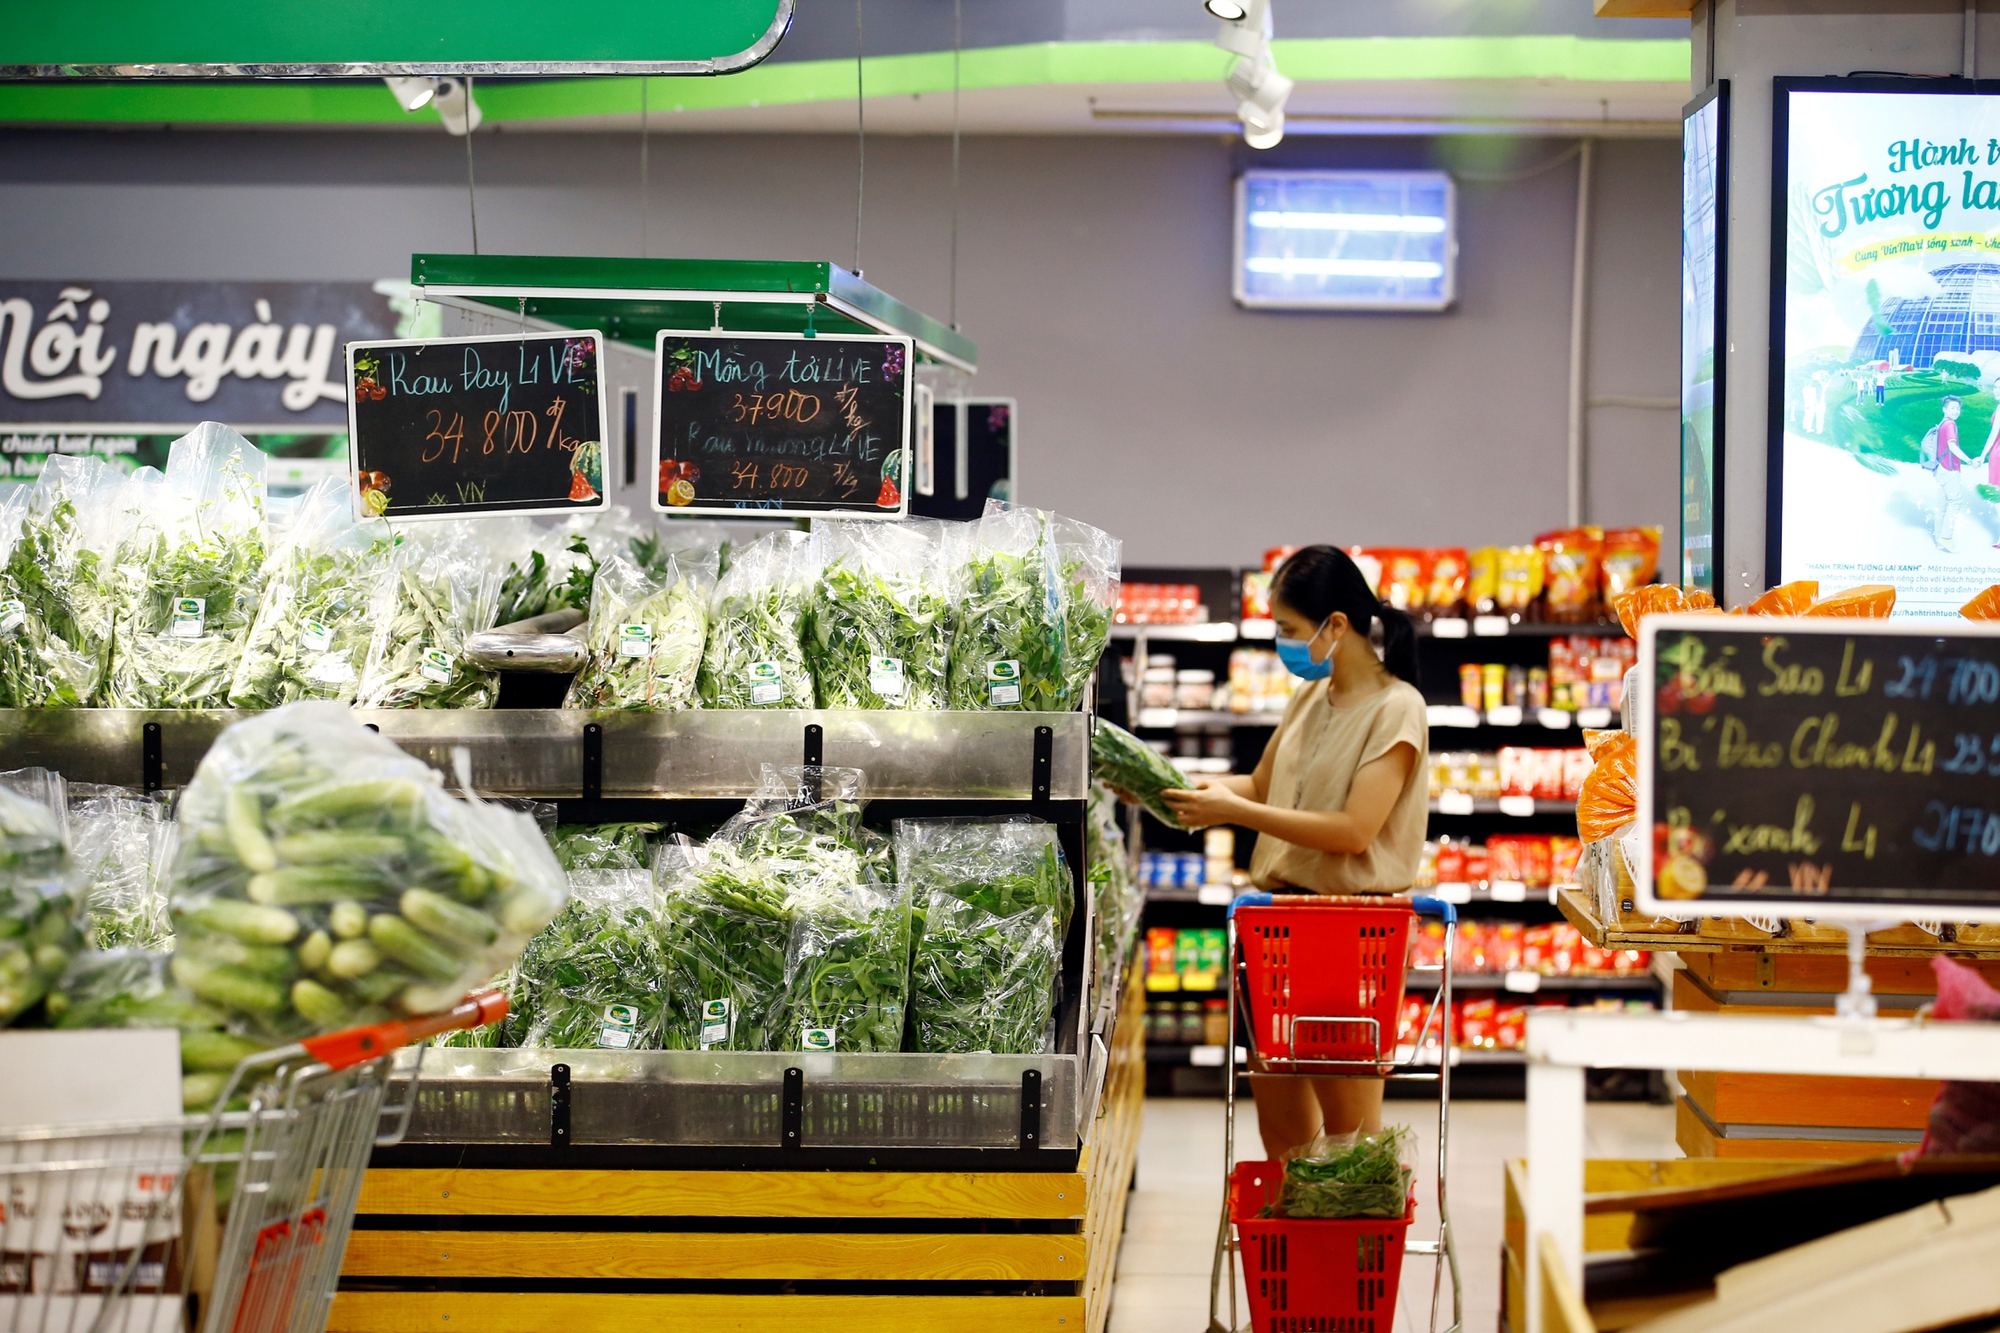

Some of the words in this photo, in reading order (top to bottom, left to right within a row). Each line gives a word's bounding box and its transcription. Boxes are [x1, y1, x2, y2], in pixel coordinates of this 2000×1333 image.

[1888, 138, 1979, 173] Hành
[1987, 138, 2000, 166] t
[1812, 172, 1951, 238] Tương
[1962, 170, 2000, 210] la
[127, 298, 347, 411] ngày
[460, 347, 512, 415] Đay
[422, 409, 537, 463] 34.800
[1758, 635, 1825, 697] Sao
[1789, 711, 1900, 773] Chanh
[1724, 794, 1823, 856] xanh
